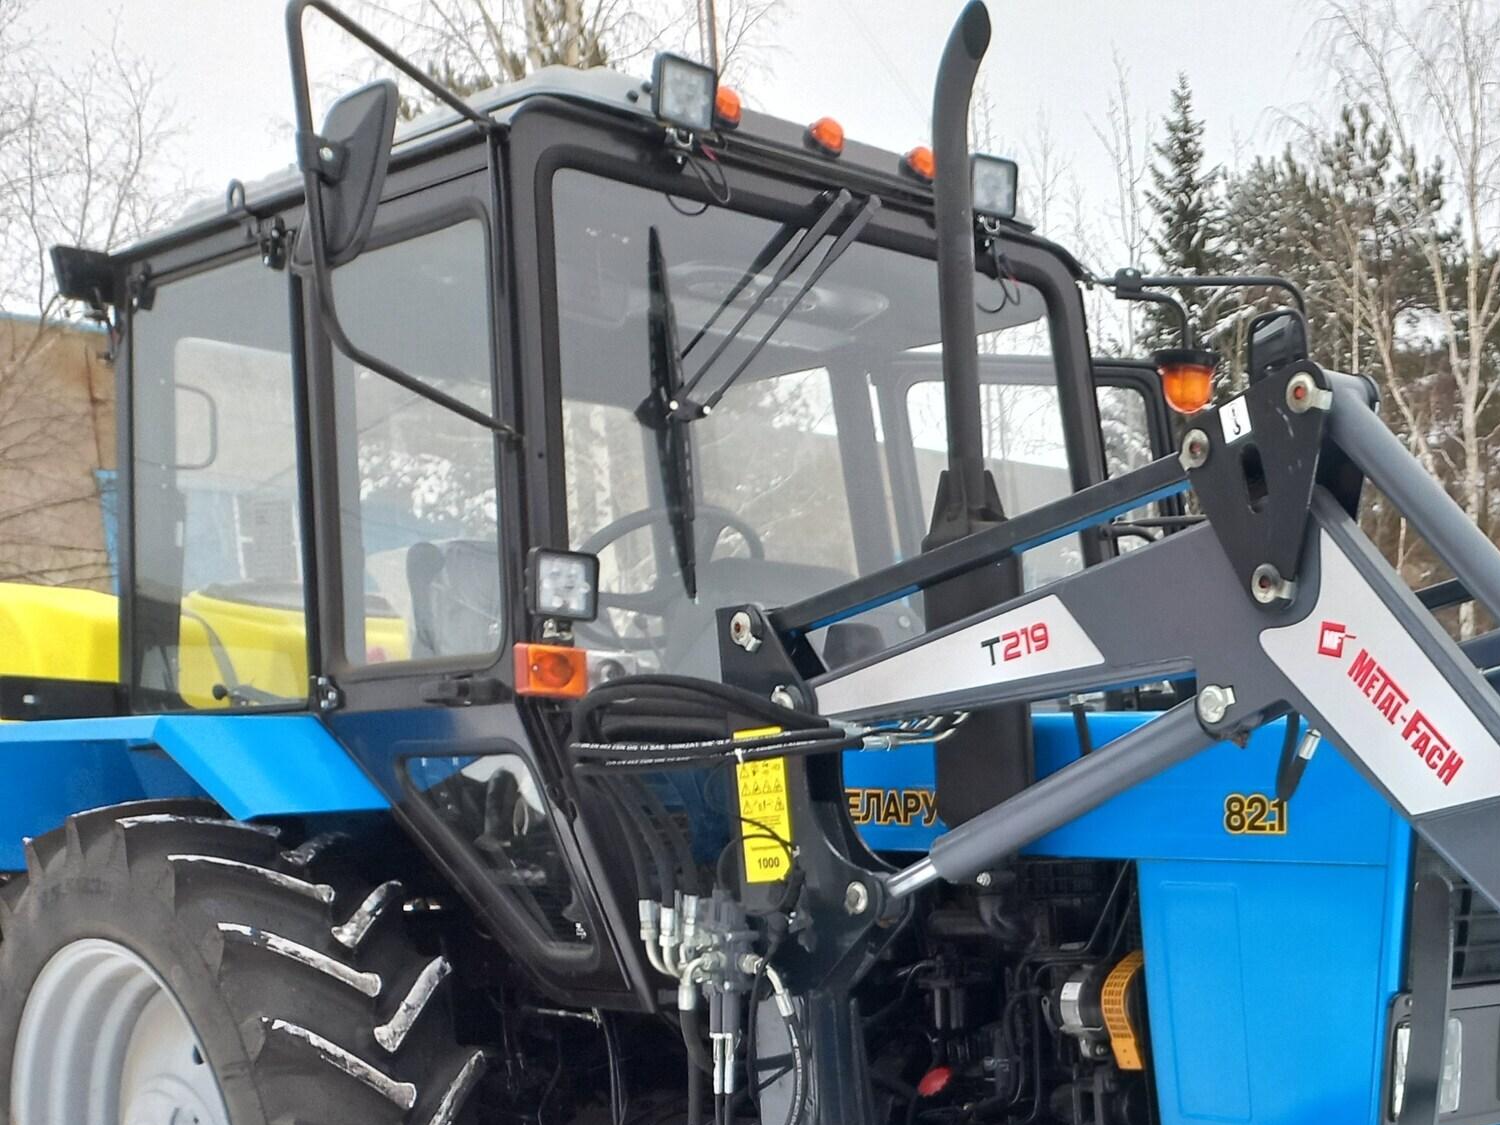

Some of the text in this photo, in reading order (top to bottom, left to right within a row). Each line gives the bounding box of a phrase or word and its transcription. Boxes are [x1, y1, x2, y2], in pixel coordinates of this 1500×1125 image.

[981, 623, 1049, 666] T219
[1347, 648, 1464, 786] METAL-FACH
[844, 788, 937, 827] ЕЛАРУ
[1224, 793, 1287, 834] 82.1
[758, 856, 780, 870] 1000
